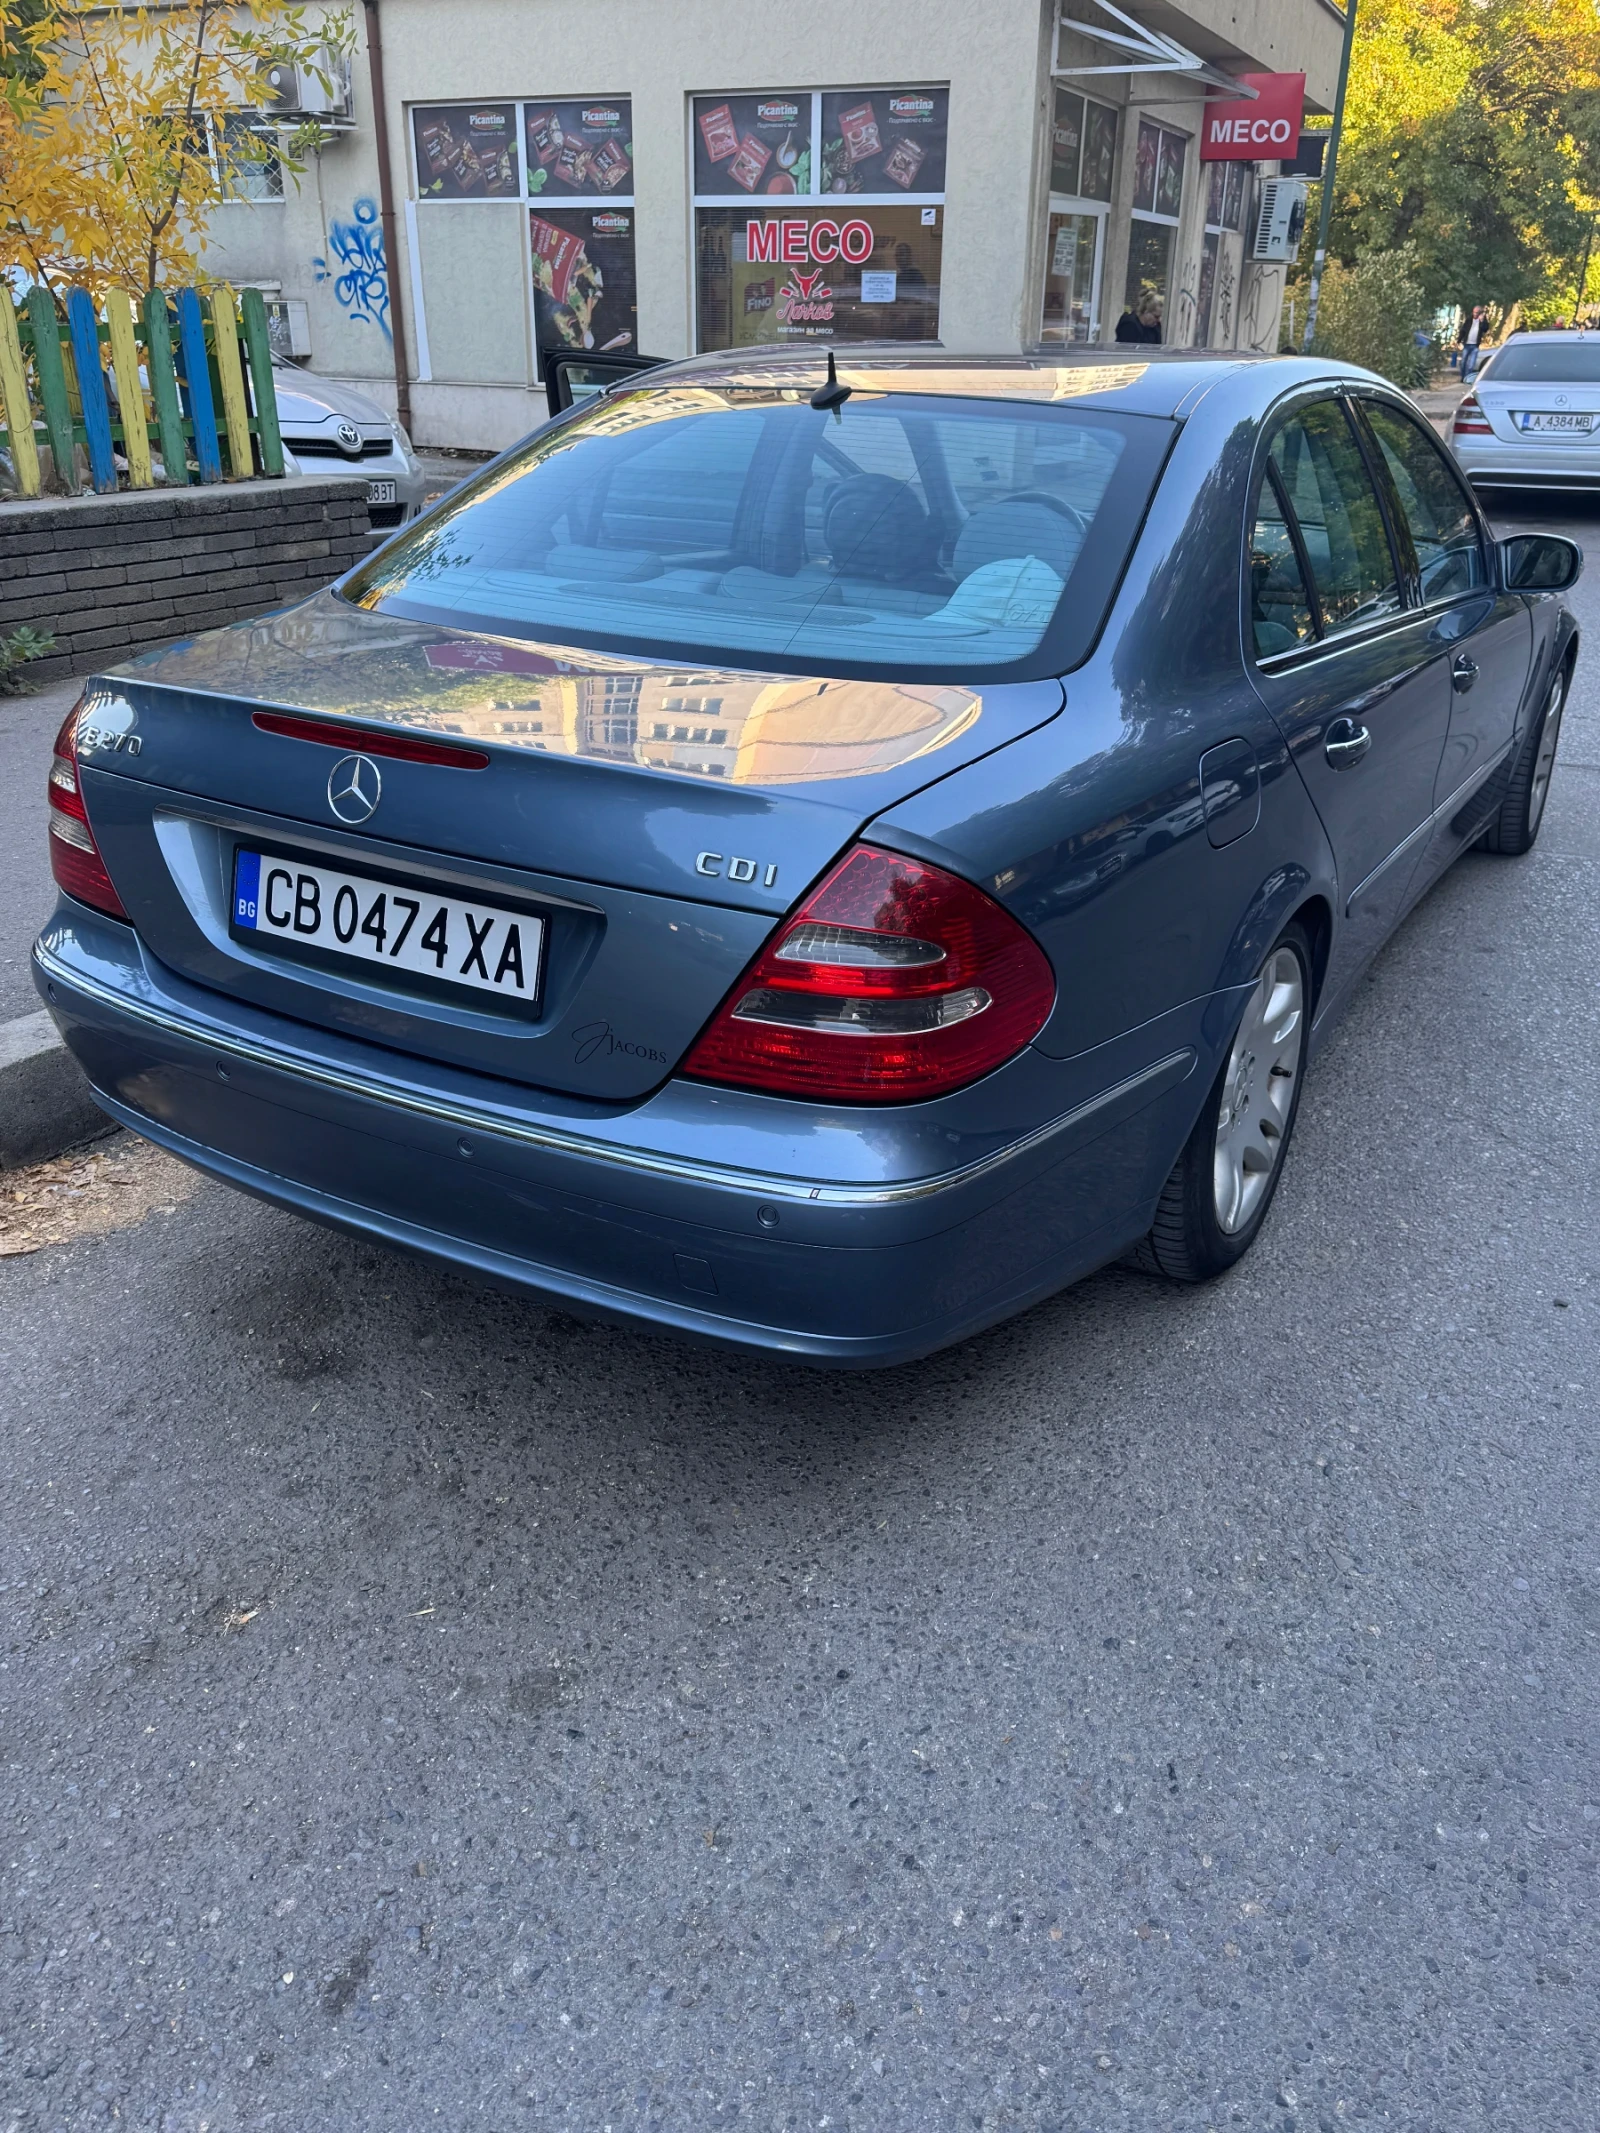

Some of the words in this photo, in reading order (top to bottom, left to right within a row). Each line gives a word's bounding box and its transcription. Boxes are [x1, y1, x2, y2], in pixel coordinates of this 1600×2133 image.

[758, 104, 798, 116] Picantina
[890, 99, 934, 110] Picantina
[470, 114, 505, 125] Picantina
[582, 110, 620, 121] Picantina
[592, 216, 629, 226] Picantina
[84, 726, 100, 748] E
[101, 730, 142, 757] 270
[696, 852, 777, 887] CDI
[238, 898, 256, 918] BG
[265, 868, 321, 934] CB
[333, 884, 448, 968] 0474
[460, 912, 525, 989] XA
